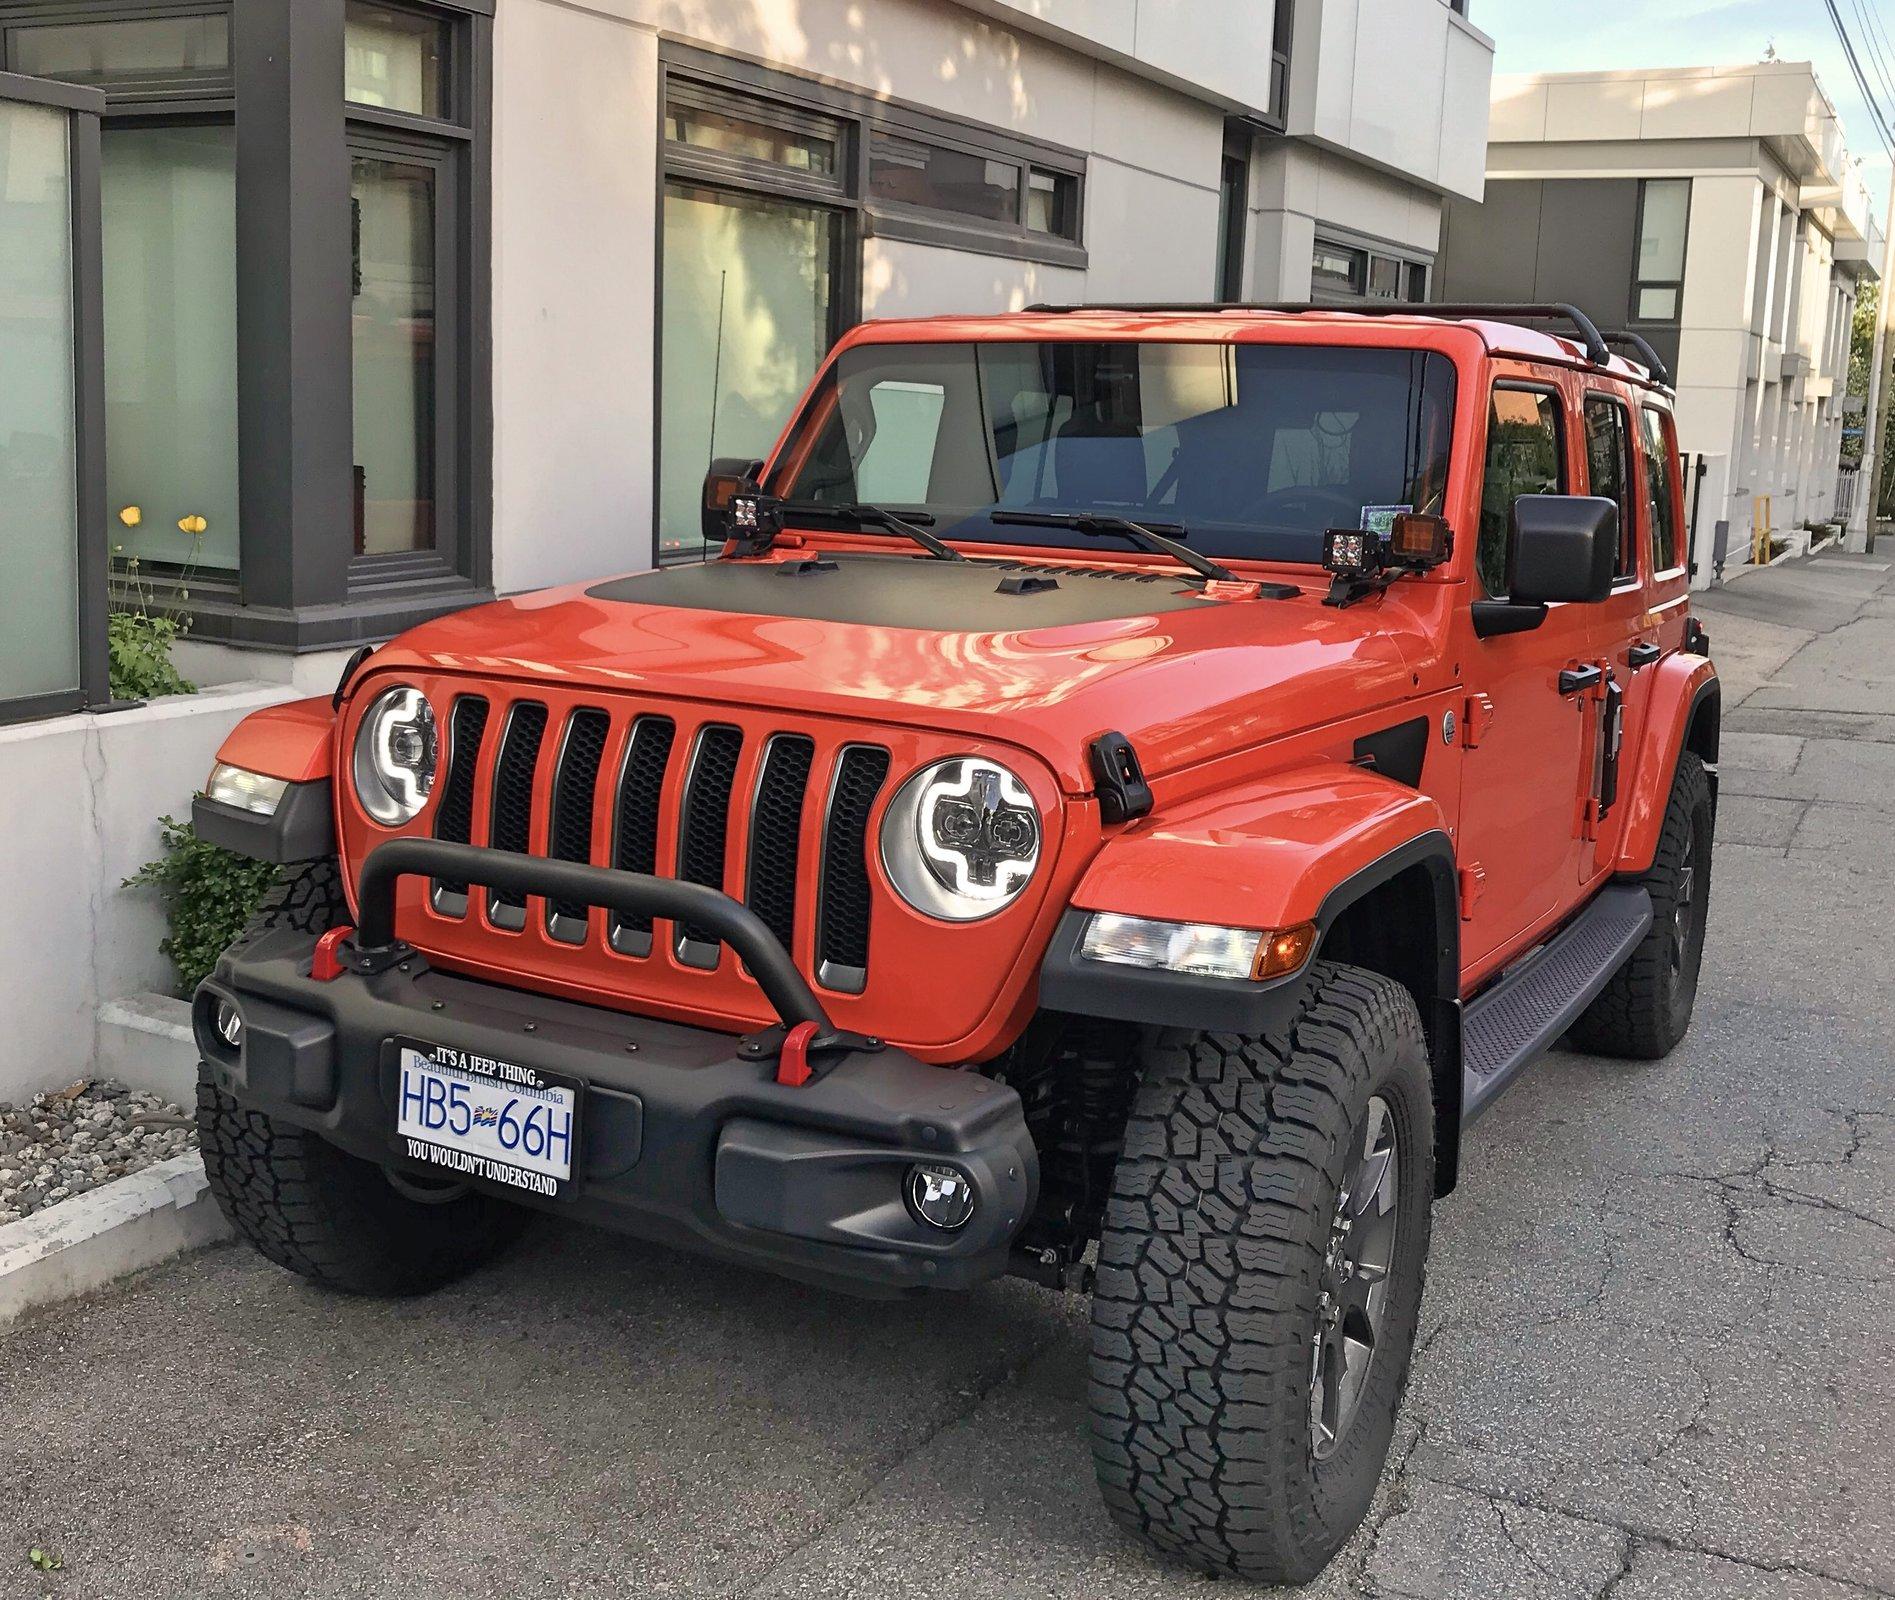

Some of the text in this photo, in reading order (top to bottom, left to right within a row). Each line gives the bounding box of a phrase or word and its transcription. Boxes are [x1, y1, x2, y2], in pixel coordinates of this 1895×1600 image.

[436, 1046, 536, 1086] IT'S A JEEP THING
[402, 1070, 571, 1165] HB5 66H
[407, 1138, 557, 1197] YOU WOULDN'T UNDERSTAND
